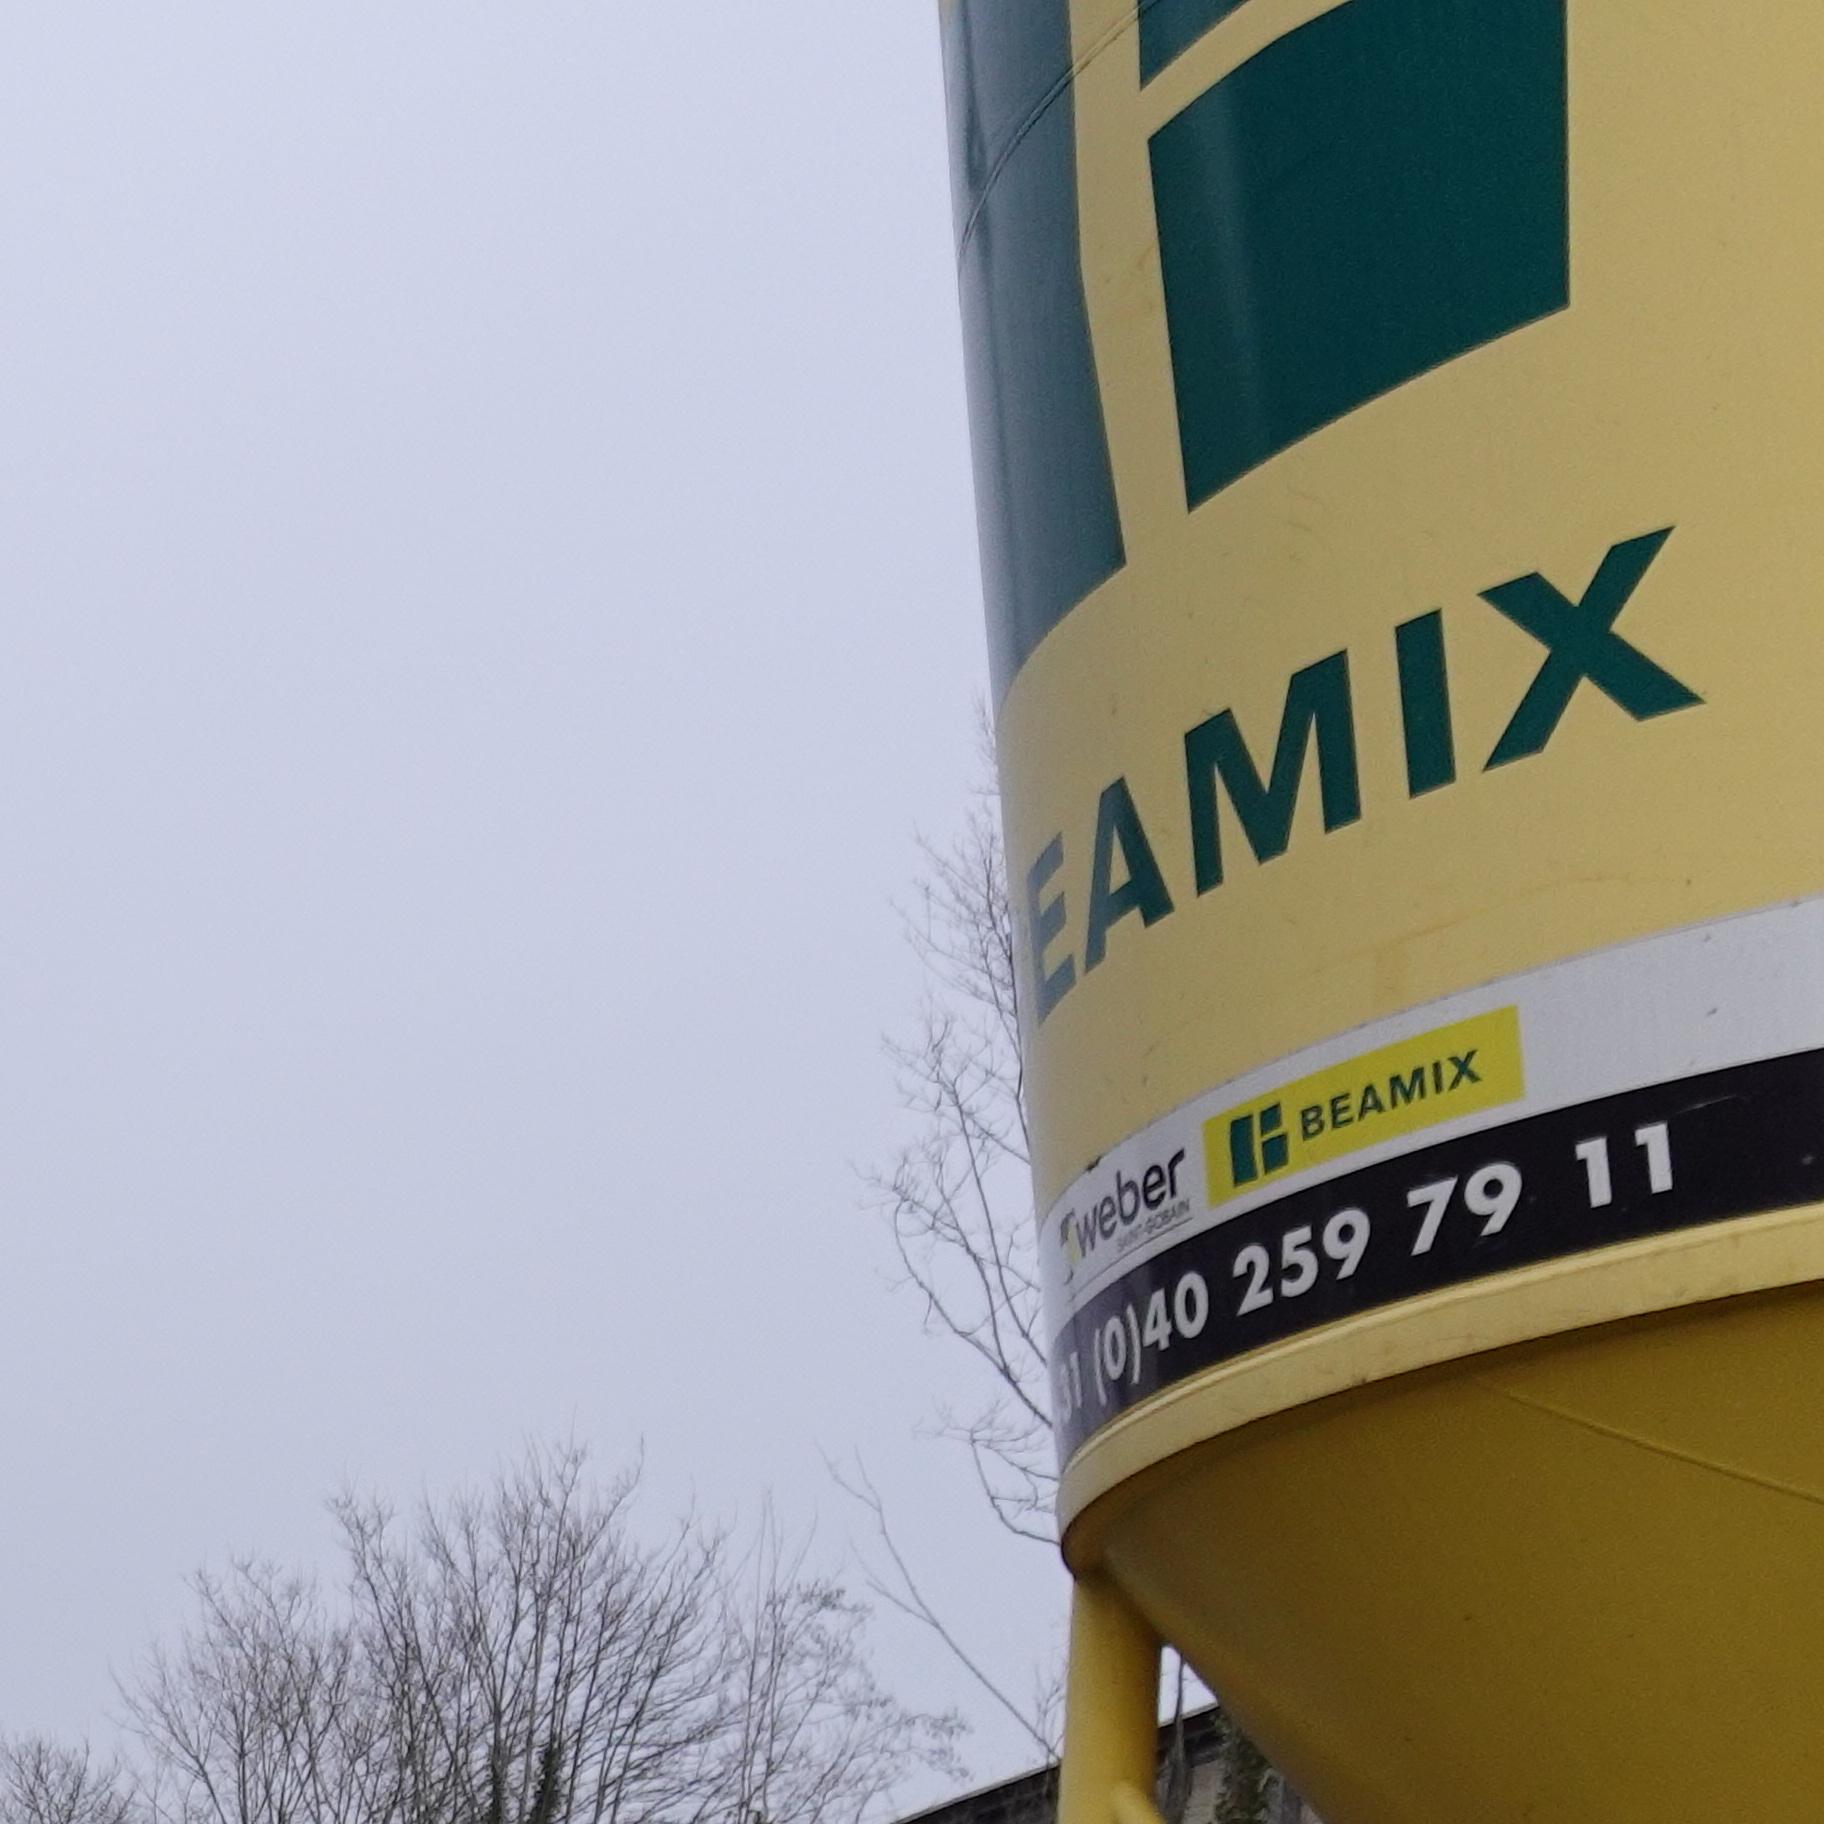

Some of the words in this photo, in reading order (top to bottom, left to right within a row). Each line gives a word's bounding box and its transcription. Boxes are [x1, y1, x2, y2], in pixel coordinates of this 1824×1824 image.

[1026, 525, 1705, 1028] EAMIX
[1300, 1049, 1483, 1141] BEAMIX
[1072, 1147, 1186, 1259] weber
[1094, 1270, 1209, 1407] (0)40
[1232, 1207, 1372, 1317] 259
[1407, 1161, 1522, 1258] 79
[1575, 1122, 1674, 1208] 11
